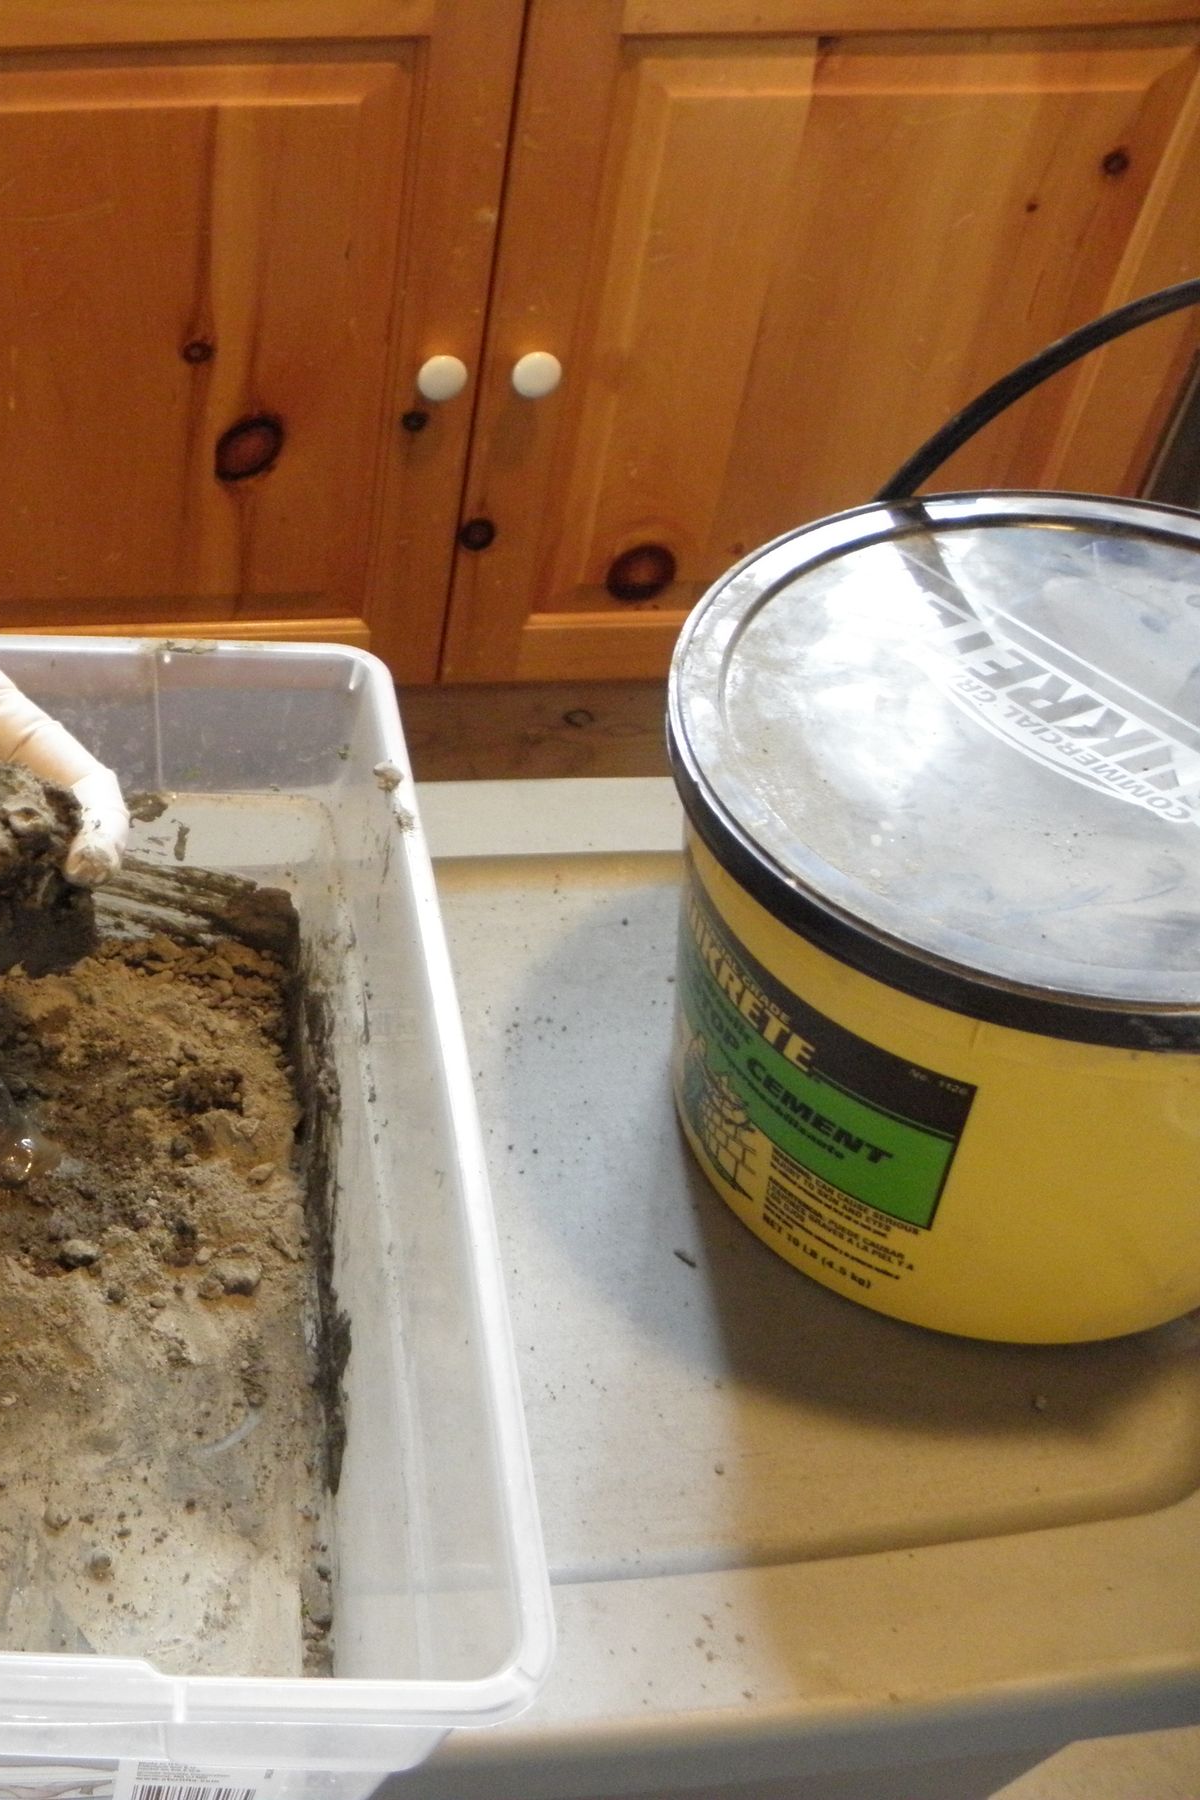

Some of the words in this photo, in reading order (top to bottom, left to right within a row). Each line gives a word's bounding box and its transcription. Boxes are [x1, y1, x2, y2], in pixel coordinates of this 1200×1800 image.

[1003, 704, 1191, 821] COMMERCIAL
[746, 1056, 895, 1165] CEMENT
[842, 1202, 863, 1219] AND
[872, 1211, 919, 1236] SERIOUS
[787, 1232, 800, 1248] 10
[802, 1244, 818, 1260] LB
[821, 1256, 847, 1276] (4.5
[850, 1272, 871, 1289] kg)
